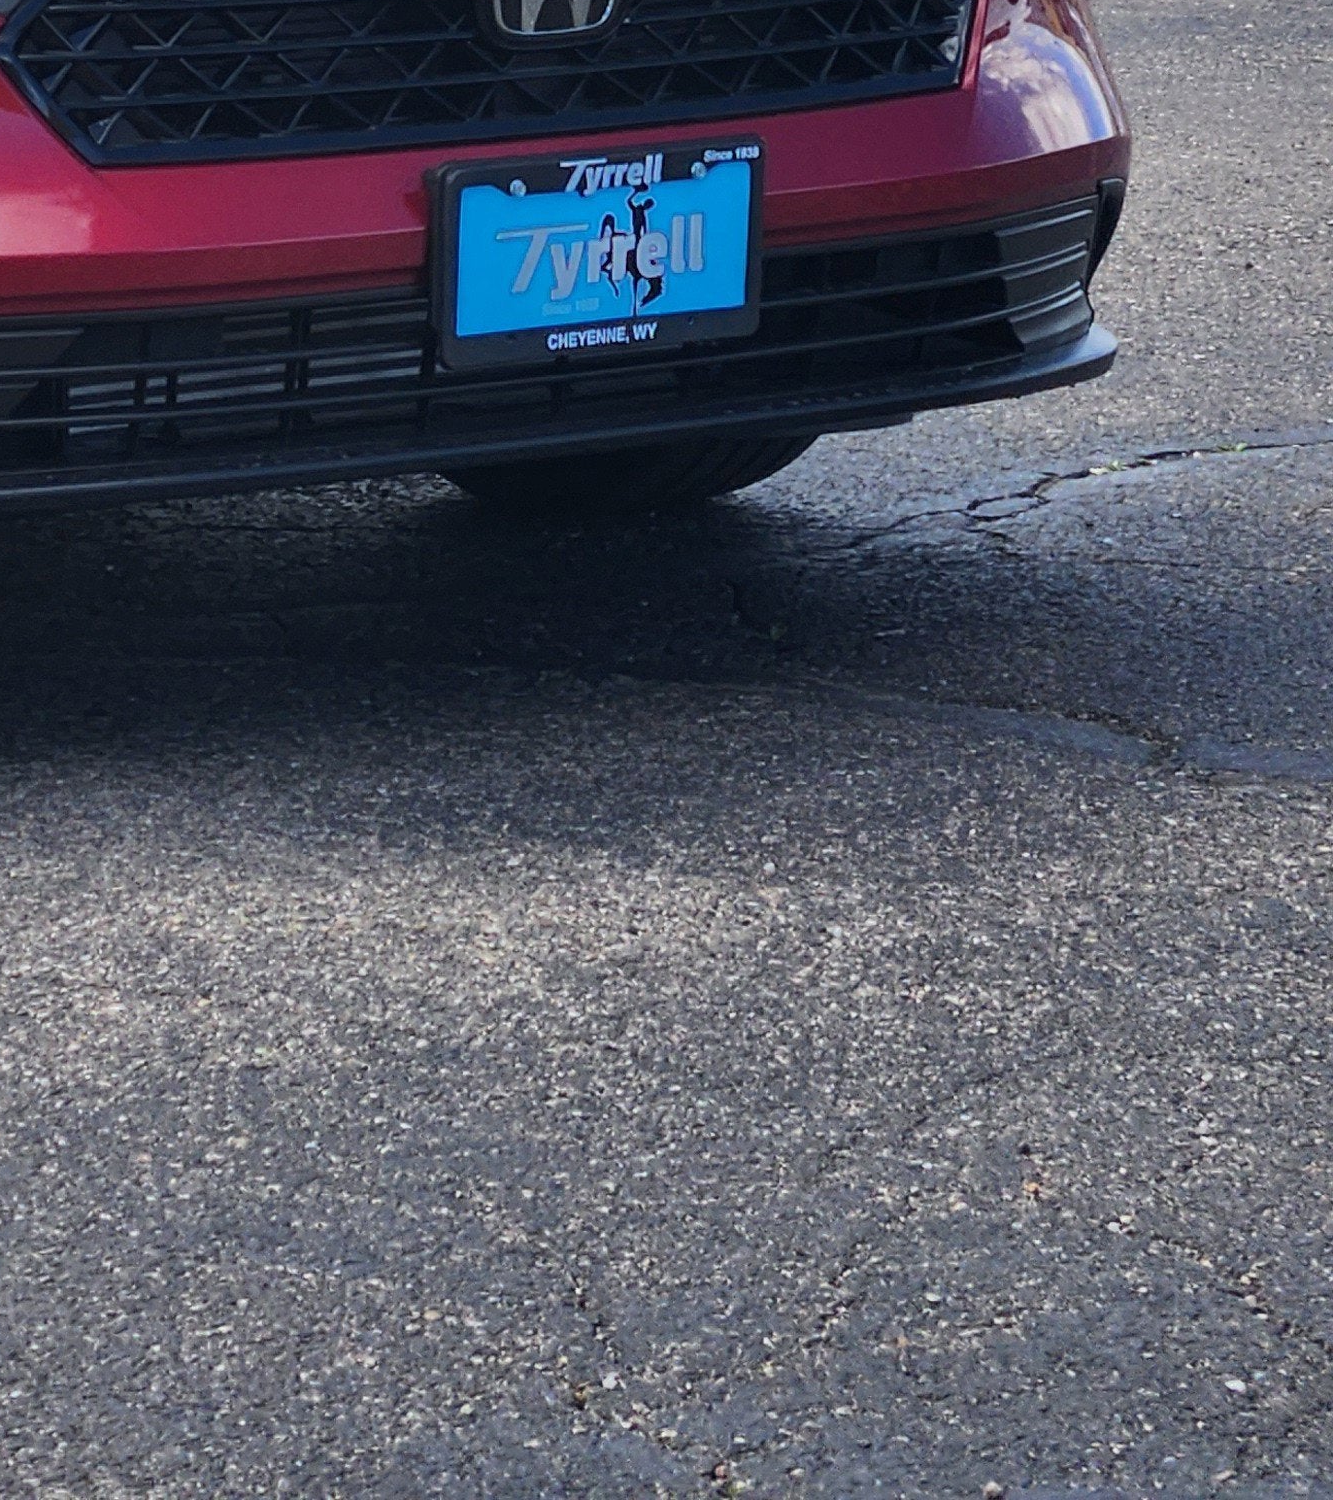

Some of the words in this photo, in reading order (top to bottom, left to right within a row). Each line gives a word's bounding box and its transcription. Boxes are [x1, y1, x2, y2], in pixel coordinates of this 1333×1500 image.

[560, 152, 663, 197] Tyrrell
[496, 213, 704, 300] Tyrrell
[547, 326, 630, 350] CHEYENNE,
[633, 322, 658, 341] WY
